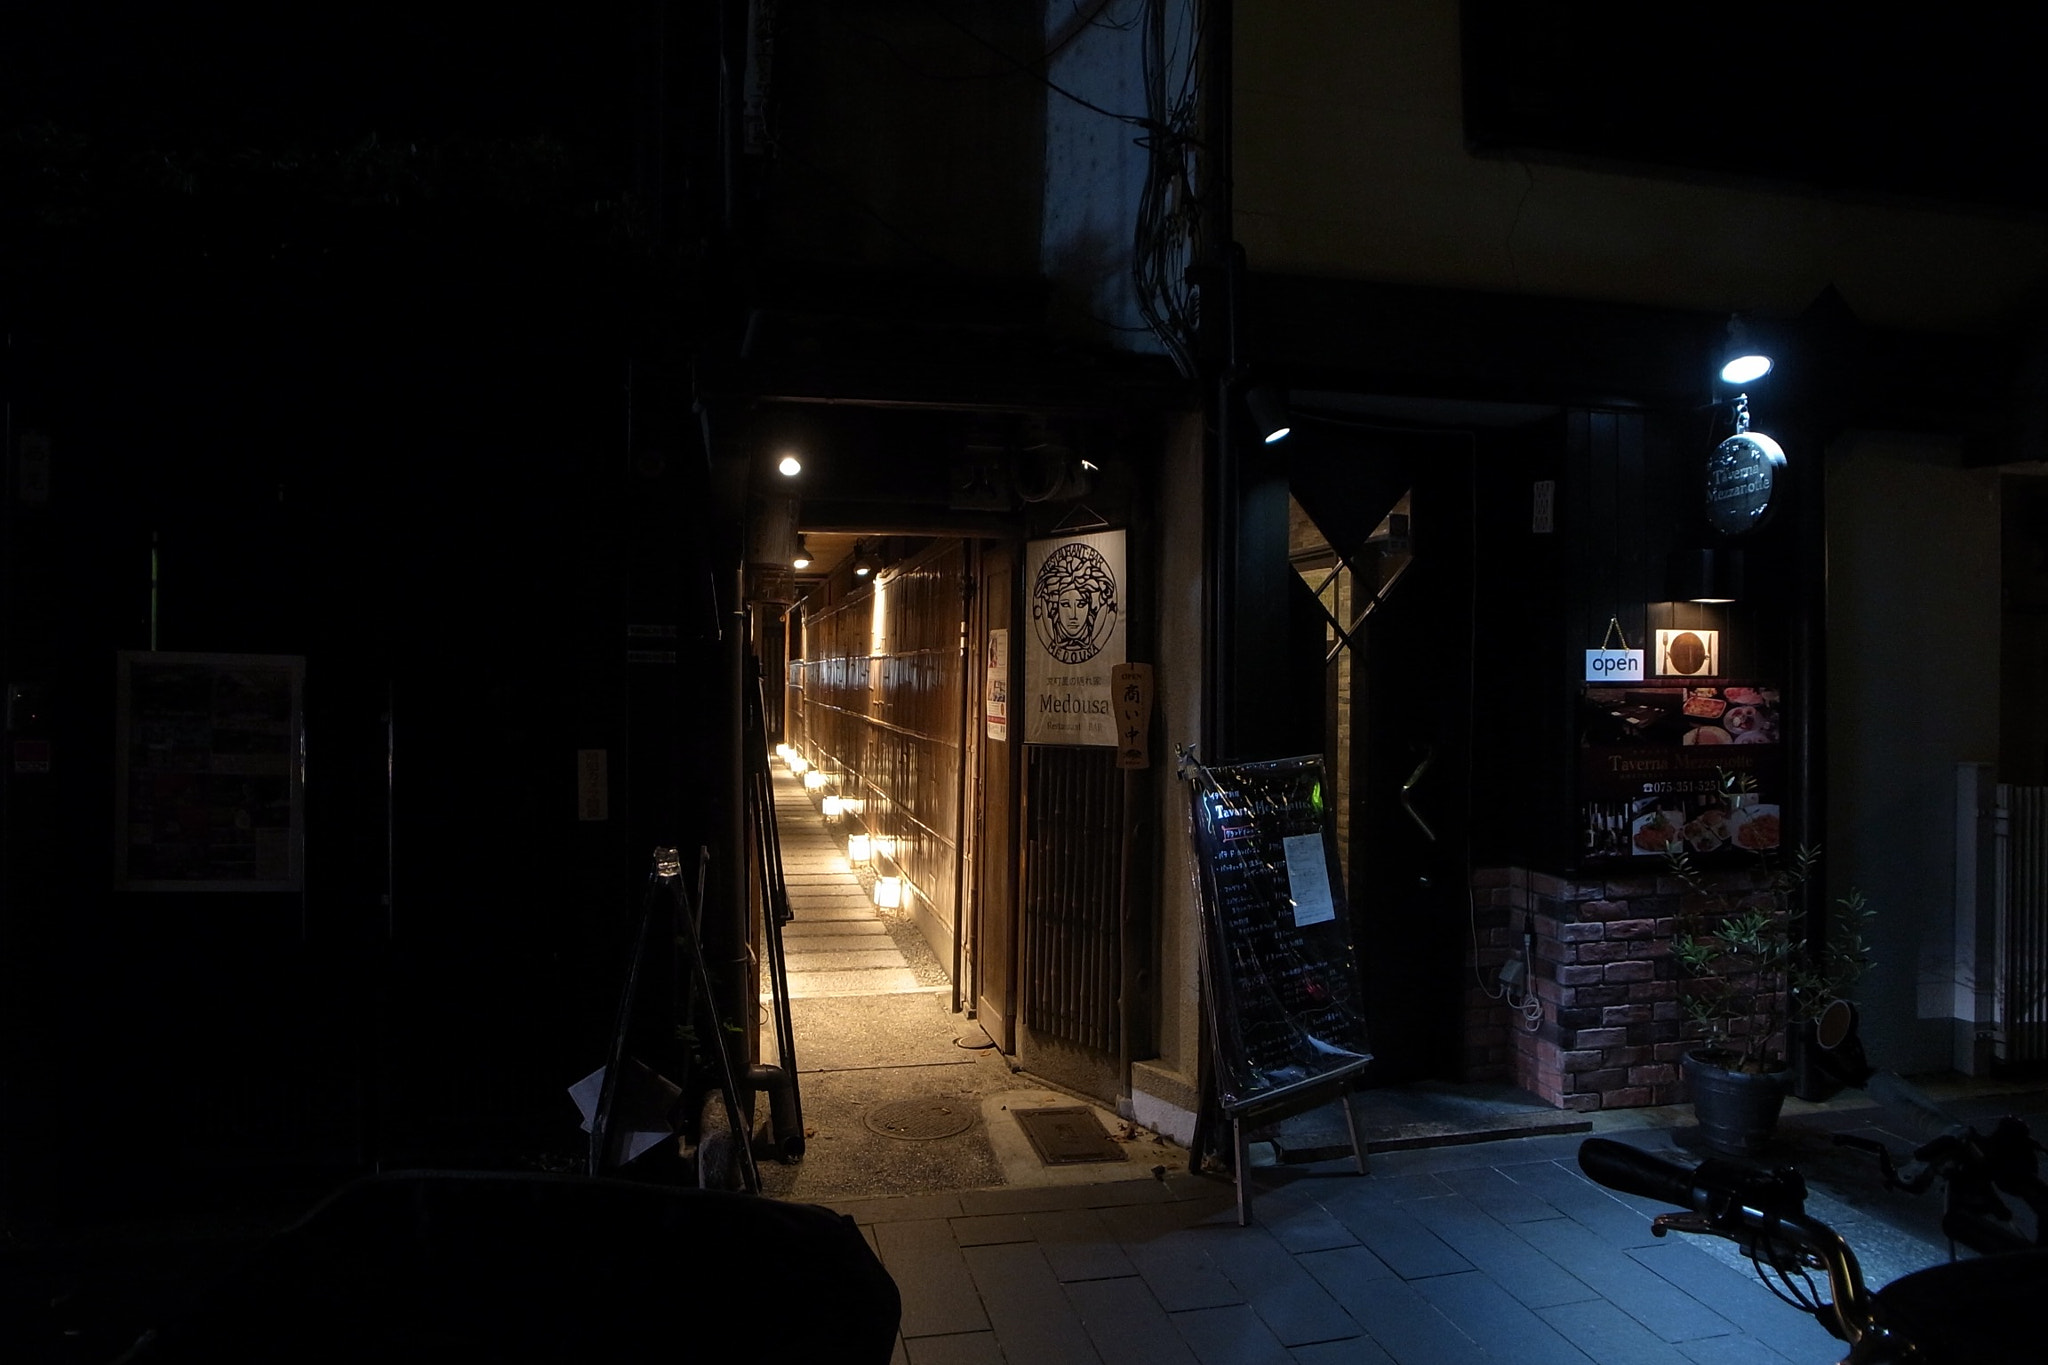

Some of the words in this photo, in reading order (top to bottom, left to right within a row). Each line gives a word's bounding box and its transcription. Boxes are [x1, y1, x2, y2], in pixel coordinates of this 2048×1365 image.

[1047, 642, 1100, 664] MEDOUSA
[1121, 672, 1142, 680] OPEN
[1592, 657, 1638, 677] open
[1039, 693, 1109, 715] Medousa
[1124, 683, 1140, 745] 商い中
[1607, 754, 1669, 772] Taverna
[1653, 780, 1721, 793] 075-351-5251
